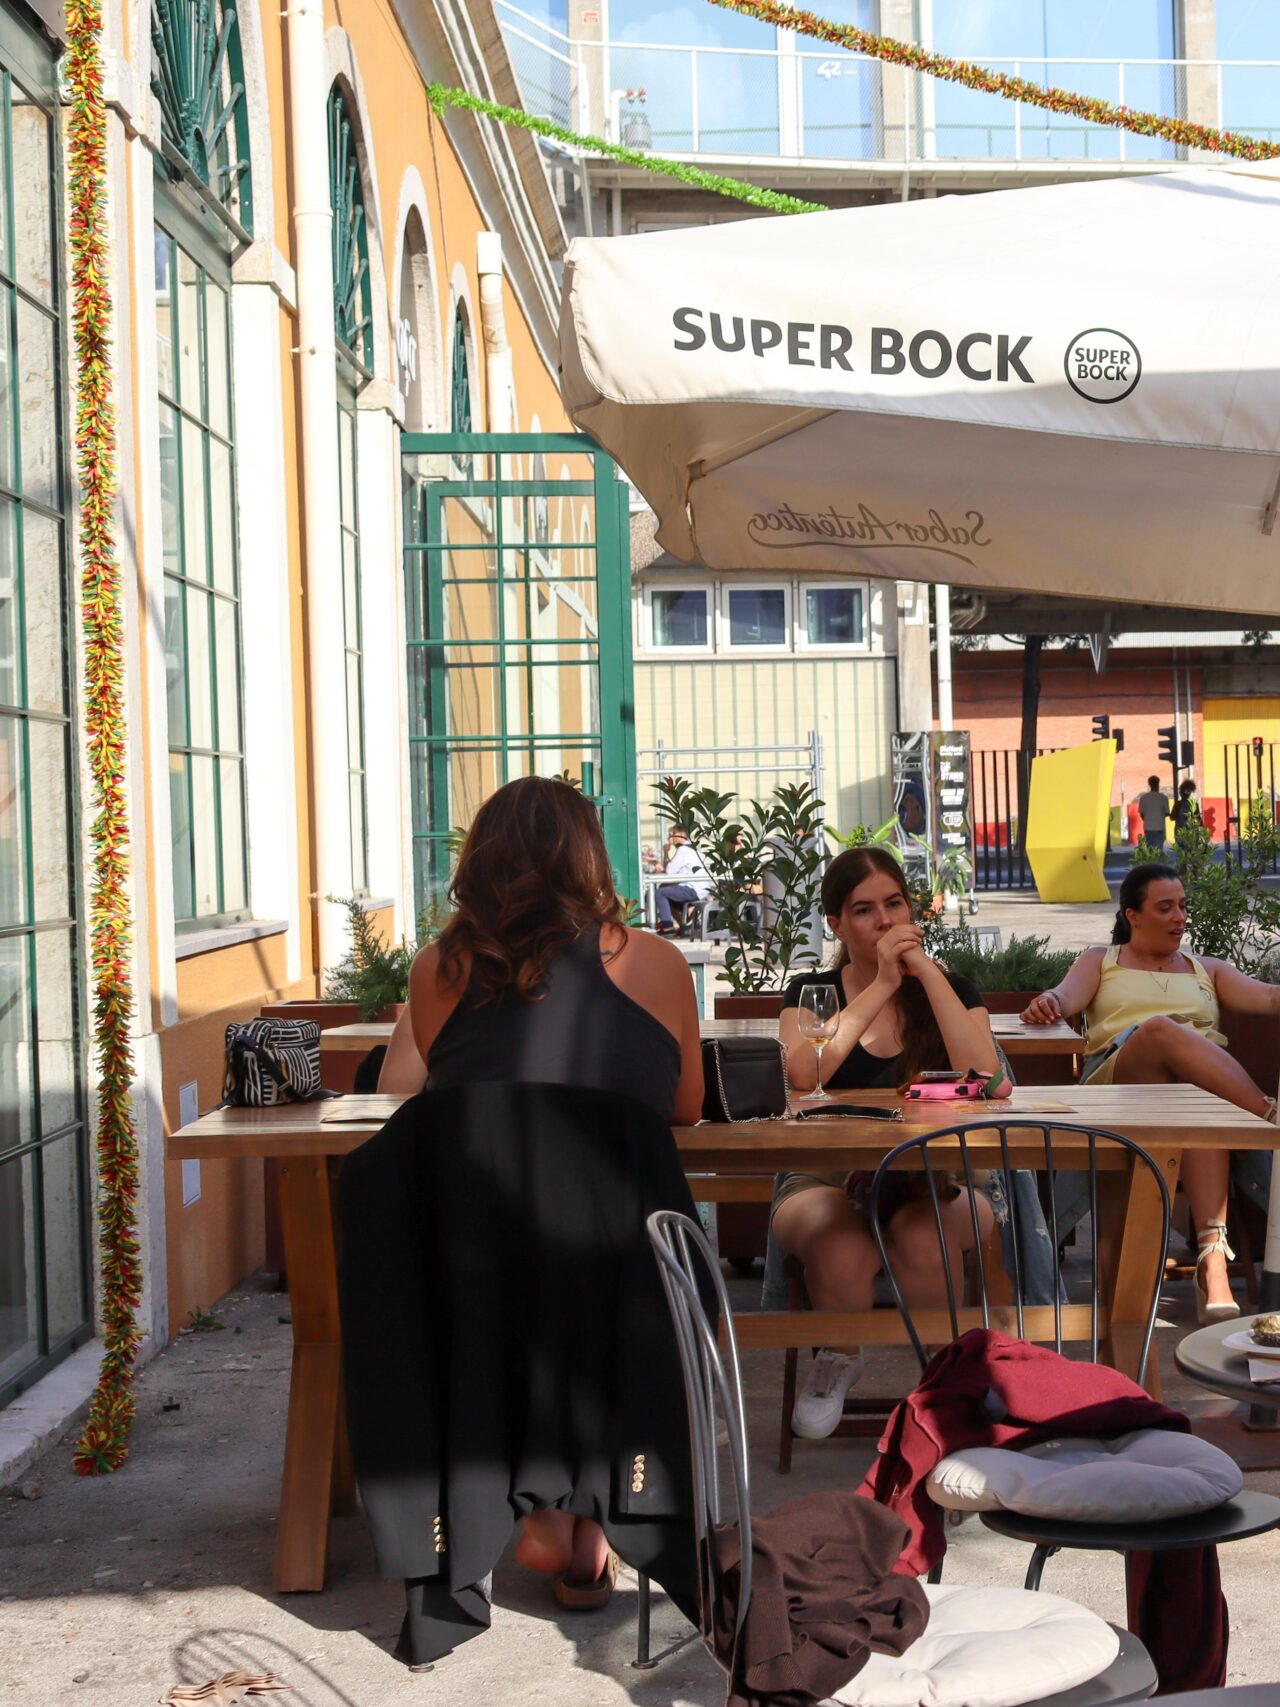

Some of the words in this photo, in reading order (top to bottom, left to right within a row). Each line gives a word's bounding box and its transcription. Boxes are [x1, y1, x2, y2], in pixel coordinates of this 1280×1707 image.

[672, 306, 855, 372] SUPER
[870, 327, 1036, 384] BOCK
[1074, 347, 1131, 365] SUPER
[1077, 364, 1128, 382] BOCK
